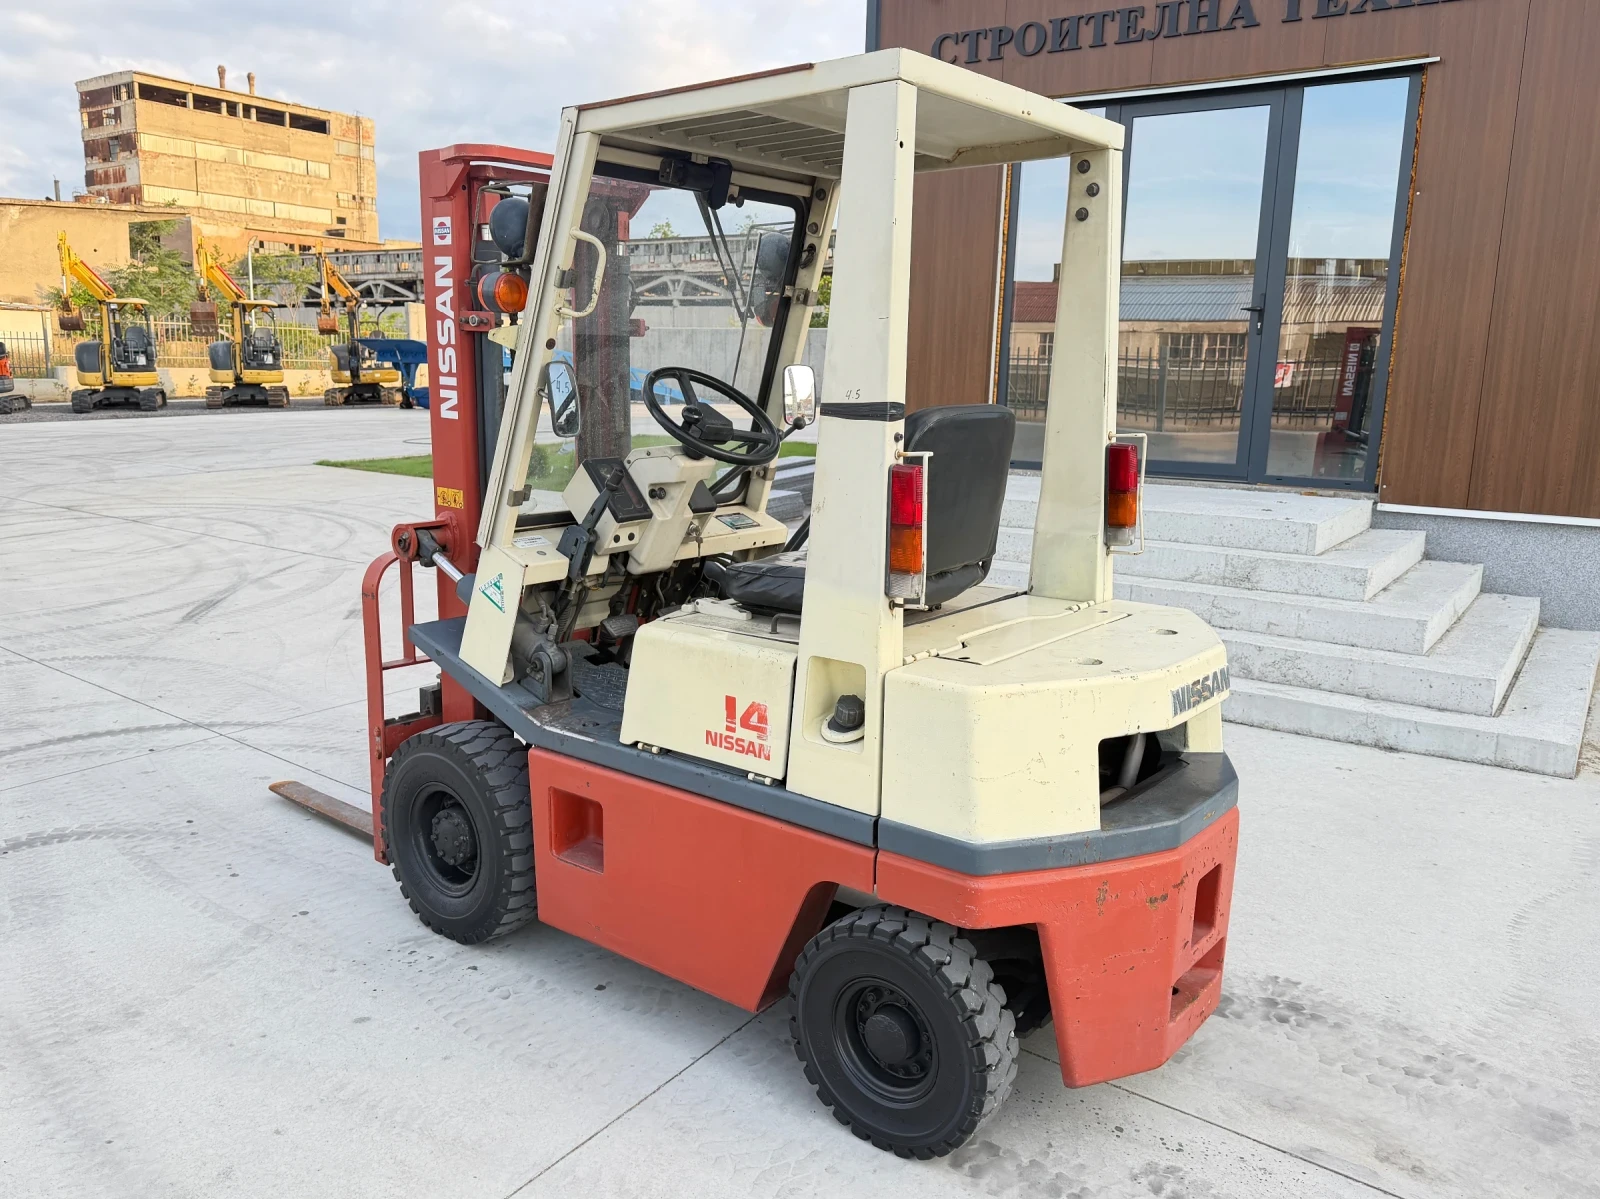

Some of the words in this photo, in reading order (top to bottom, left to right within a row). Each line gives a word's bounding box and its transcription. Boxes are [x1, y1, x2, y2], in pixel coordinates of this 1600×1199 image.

[931, 0, 1261, 64] СТРОИТЕЛНА
[434, 256, 459, 420] NISSAN
[1171, 665, 1230, 717] NISSAN
[725, 694, 769, 741] 14
[705, 729, 771, 761] NISSAN
